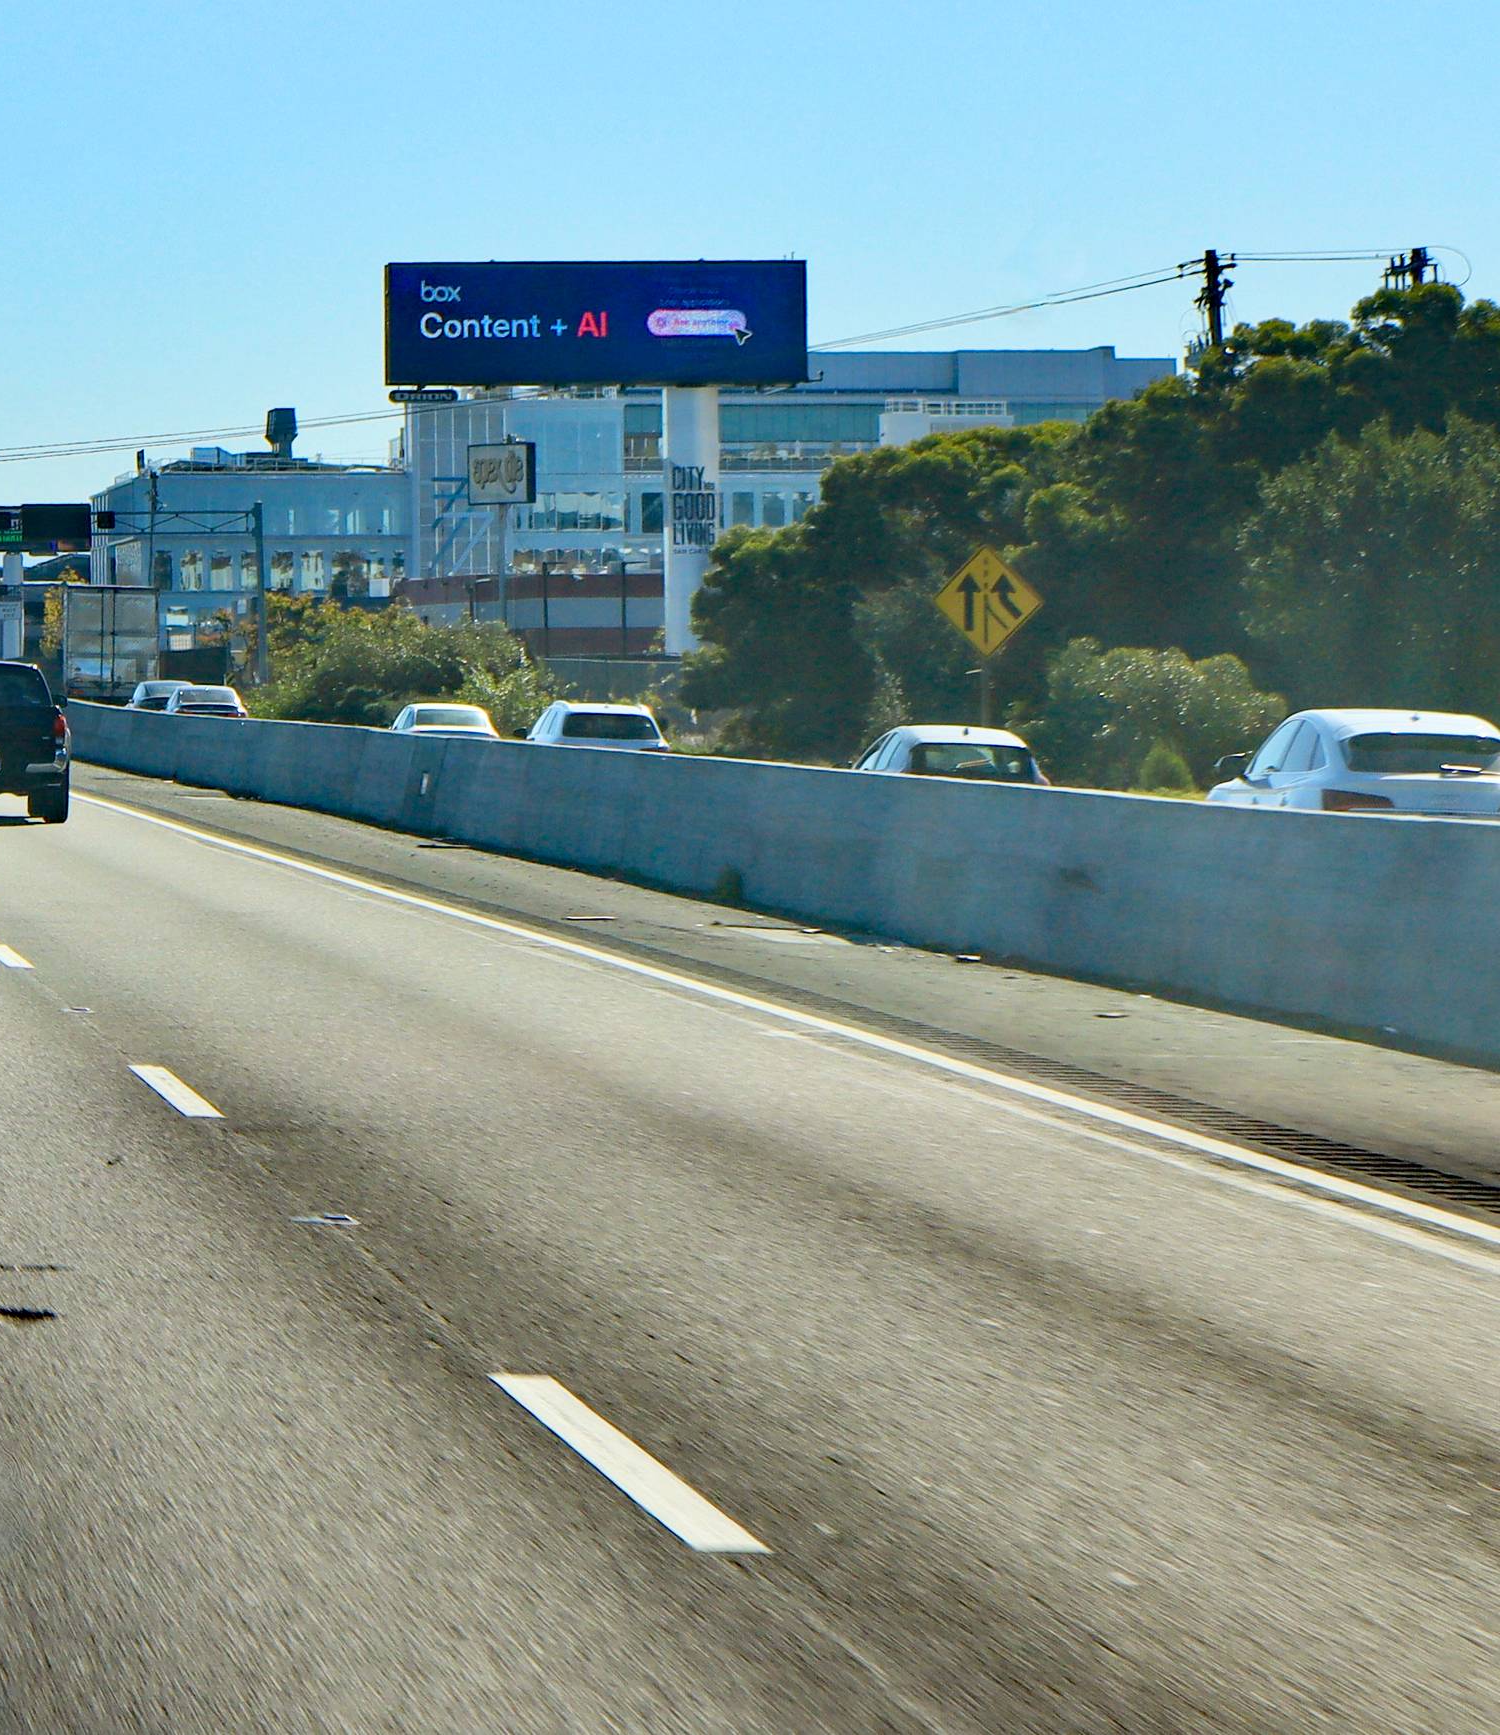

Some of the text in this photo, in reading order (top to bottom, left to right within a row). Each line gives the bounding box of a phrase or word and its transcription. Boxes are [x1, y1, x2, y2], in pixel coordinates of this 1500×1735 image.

[420, 280, 461, 302] box
[420, 311, 608, 339] Content + AI
[672, 466, 705, 491] CITY
[672, 493, 716, 521] GOOD
[672, 522, 716, 546] LIVING
